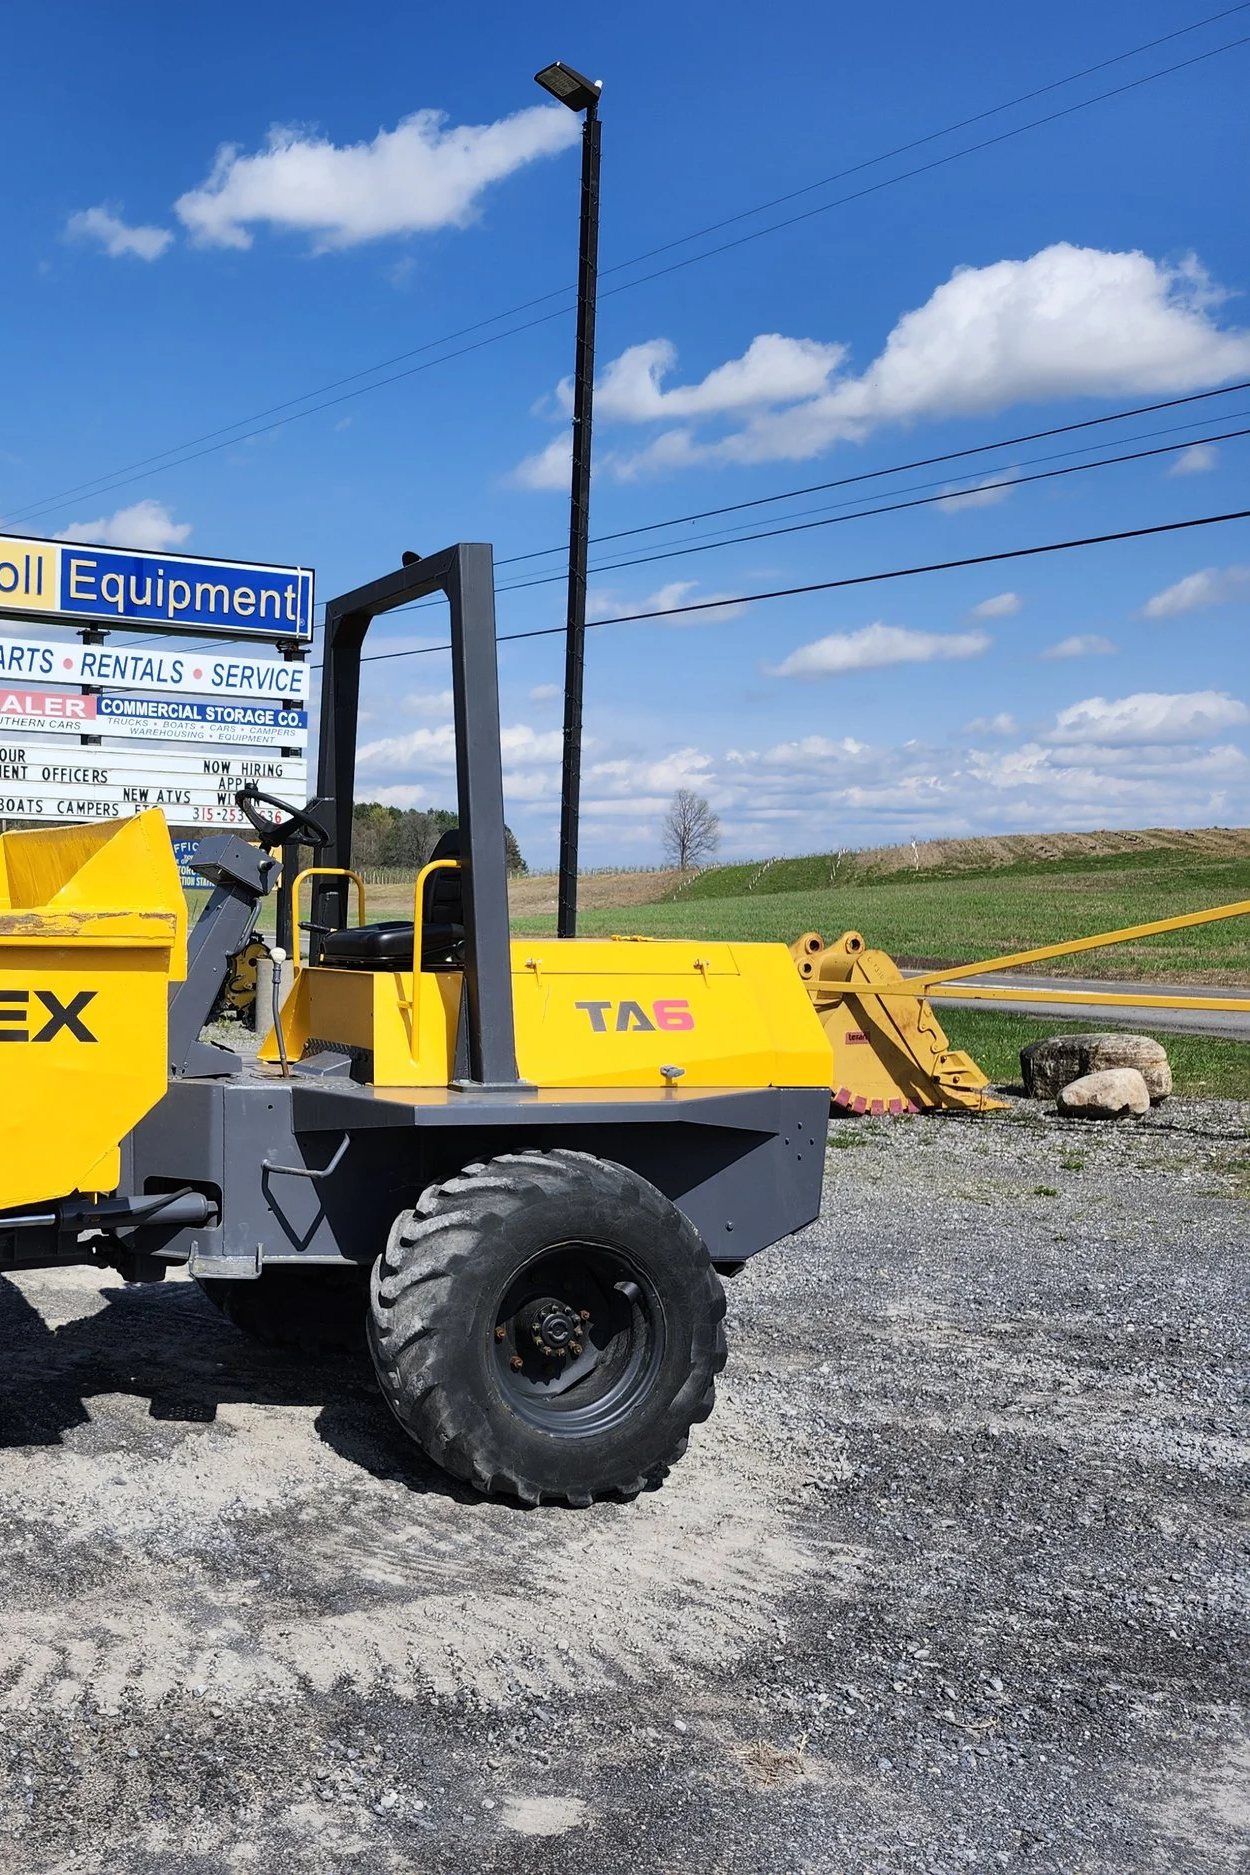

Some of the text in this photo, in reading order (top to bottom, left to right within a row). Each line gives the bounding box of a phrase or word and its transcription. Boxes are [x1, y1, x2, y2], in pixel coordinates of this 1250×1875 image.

[69, 558, 297, 621] Equipment
[80, 652, 184, 684] RENTALS
[211, 663, 304, 692] SERVICE
[101, 699, 303, 727] COMMERCIAL STORAGE CO.
[49, 720, 82, 730] CARS
[107, 717, 296, 737] TRUCKS BOATS CARS CAMPERS
[129, 727, 276, 744] WAREHOUSING EQUIPMENT
[42, 767, 108, 784] OFFICERS
[203, 760, 283, 777] NOW HIRING
[123, 787, 191, 804] NEW ATVS
[57, 800, 119, 816] CAMPERS
[574, 1000, 695, 1032] TA6
